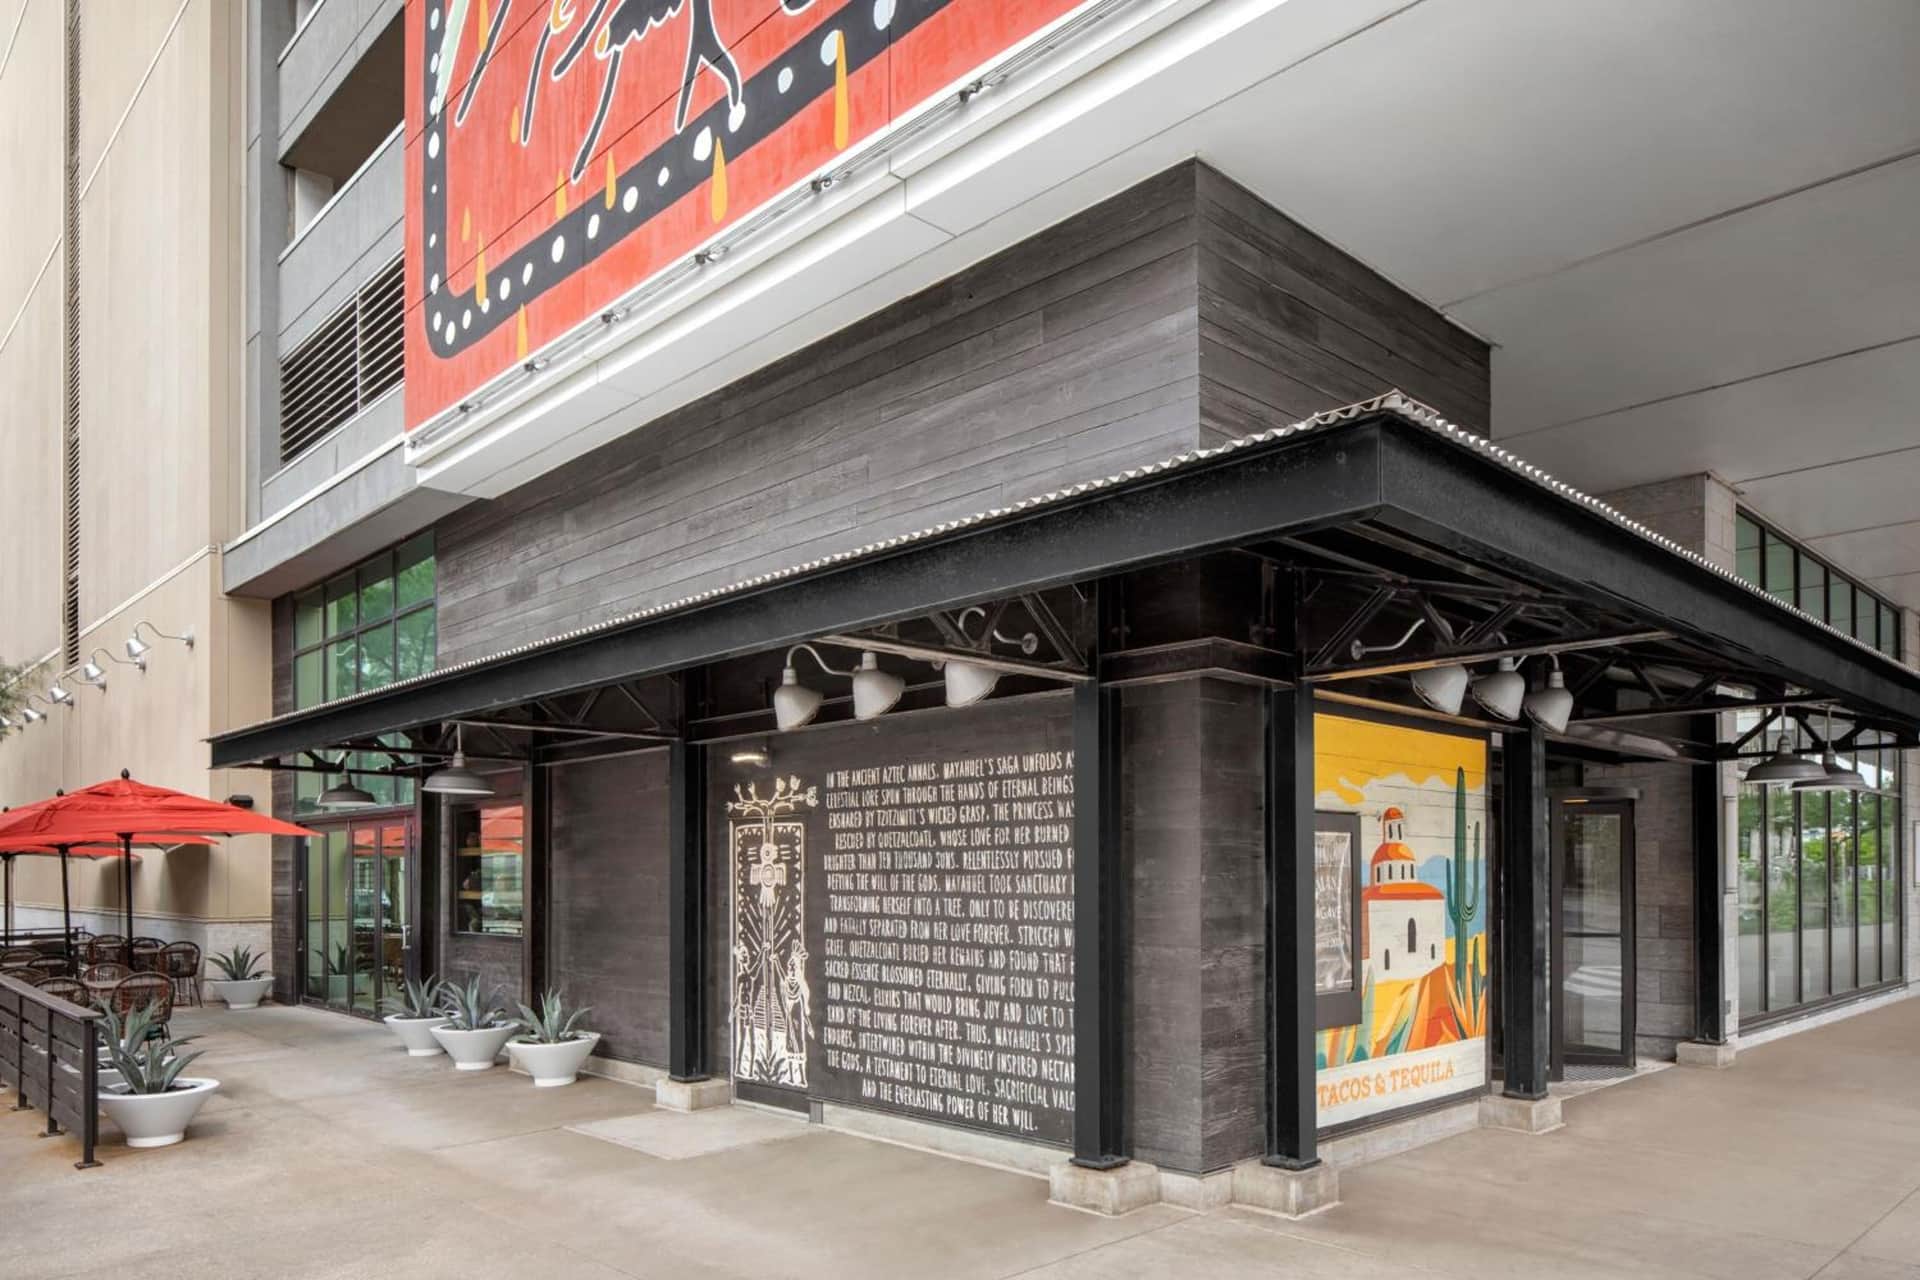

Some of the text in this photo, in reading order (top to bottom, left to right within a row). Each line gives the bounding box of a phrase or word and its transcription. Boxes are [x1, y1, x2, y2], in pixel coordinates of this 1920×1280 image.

[997, 756, 1019, 775] SAGA
[1022, 752, 1062, 773] UNFOLDS
[958, 782, 984, 801] HANDS
[988, 781, 999, 799] OF
[1002, 778, 1039, 798] ETERNAL
[993, 804, 1008, 822] THE
[1013, 801, 1053, 821] PRINCESS
[970, 827, 991, 846] LOVE
[995, 826, 1010, 846] FOR
[1014, 826, 1030, 845] HER
[1034, 824, 1069, 844] BURNED
[963, 849, 1019, 870] RELENTLESSLY
[1023, 848, 1062, 870] PURSUED
[945, 874, 986, 892] MAYAHUEL
[989, 875, 1011, 893] TOOK
[1016, 875, 1067, 894] SANCTUARY
[969, 898, 990, 918] ONLY
[993, 898, 1005, 919] TO
[1009, 899, 1019, 919] BE
[950, 923, 970, 942] LOVE
[1018, 926, 1060, 947] STRICKEN
[950, 947, 984, 967] REMAINS
[988, 950, 1005, 969] AND
[1009, 951, 1038, 972] FOUND
[1042, 953, 1066, 974] THAT
[976, 974, 1006, 995] GIVING
[1009, 976, 1033, 998] FORM
[1036, 979, 1049, 999] TO
[955, 996, 980, 1017] BRING
[984, 999, 1000, 1020] JOY
[1003, 1001, 1021, 1022] AND
[1025, 1003, 1048, 1025] LOVE
[1051, 1006, 1064, 1027] TO
[956, 1046, 994, 1071] DIVINELY
[997, 1051, 1038, 1078] INSPIRED
[994, 1077, 1049, 1107] SACRIFICIAL
[1318, 1057, 1455, 1108] TACOS & TEQUILA
[946, 1095, 974, 1119] POWER
[977, 1101, 989, 1122] OF
[992, 1104, 1009, 1126] HER
